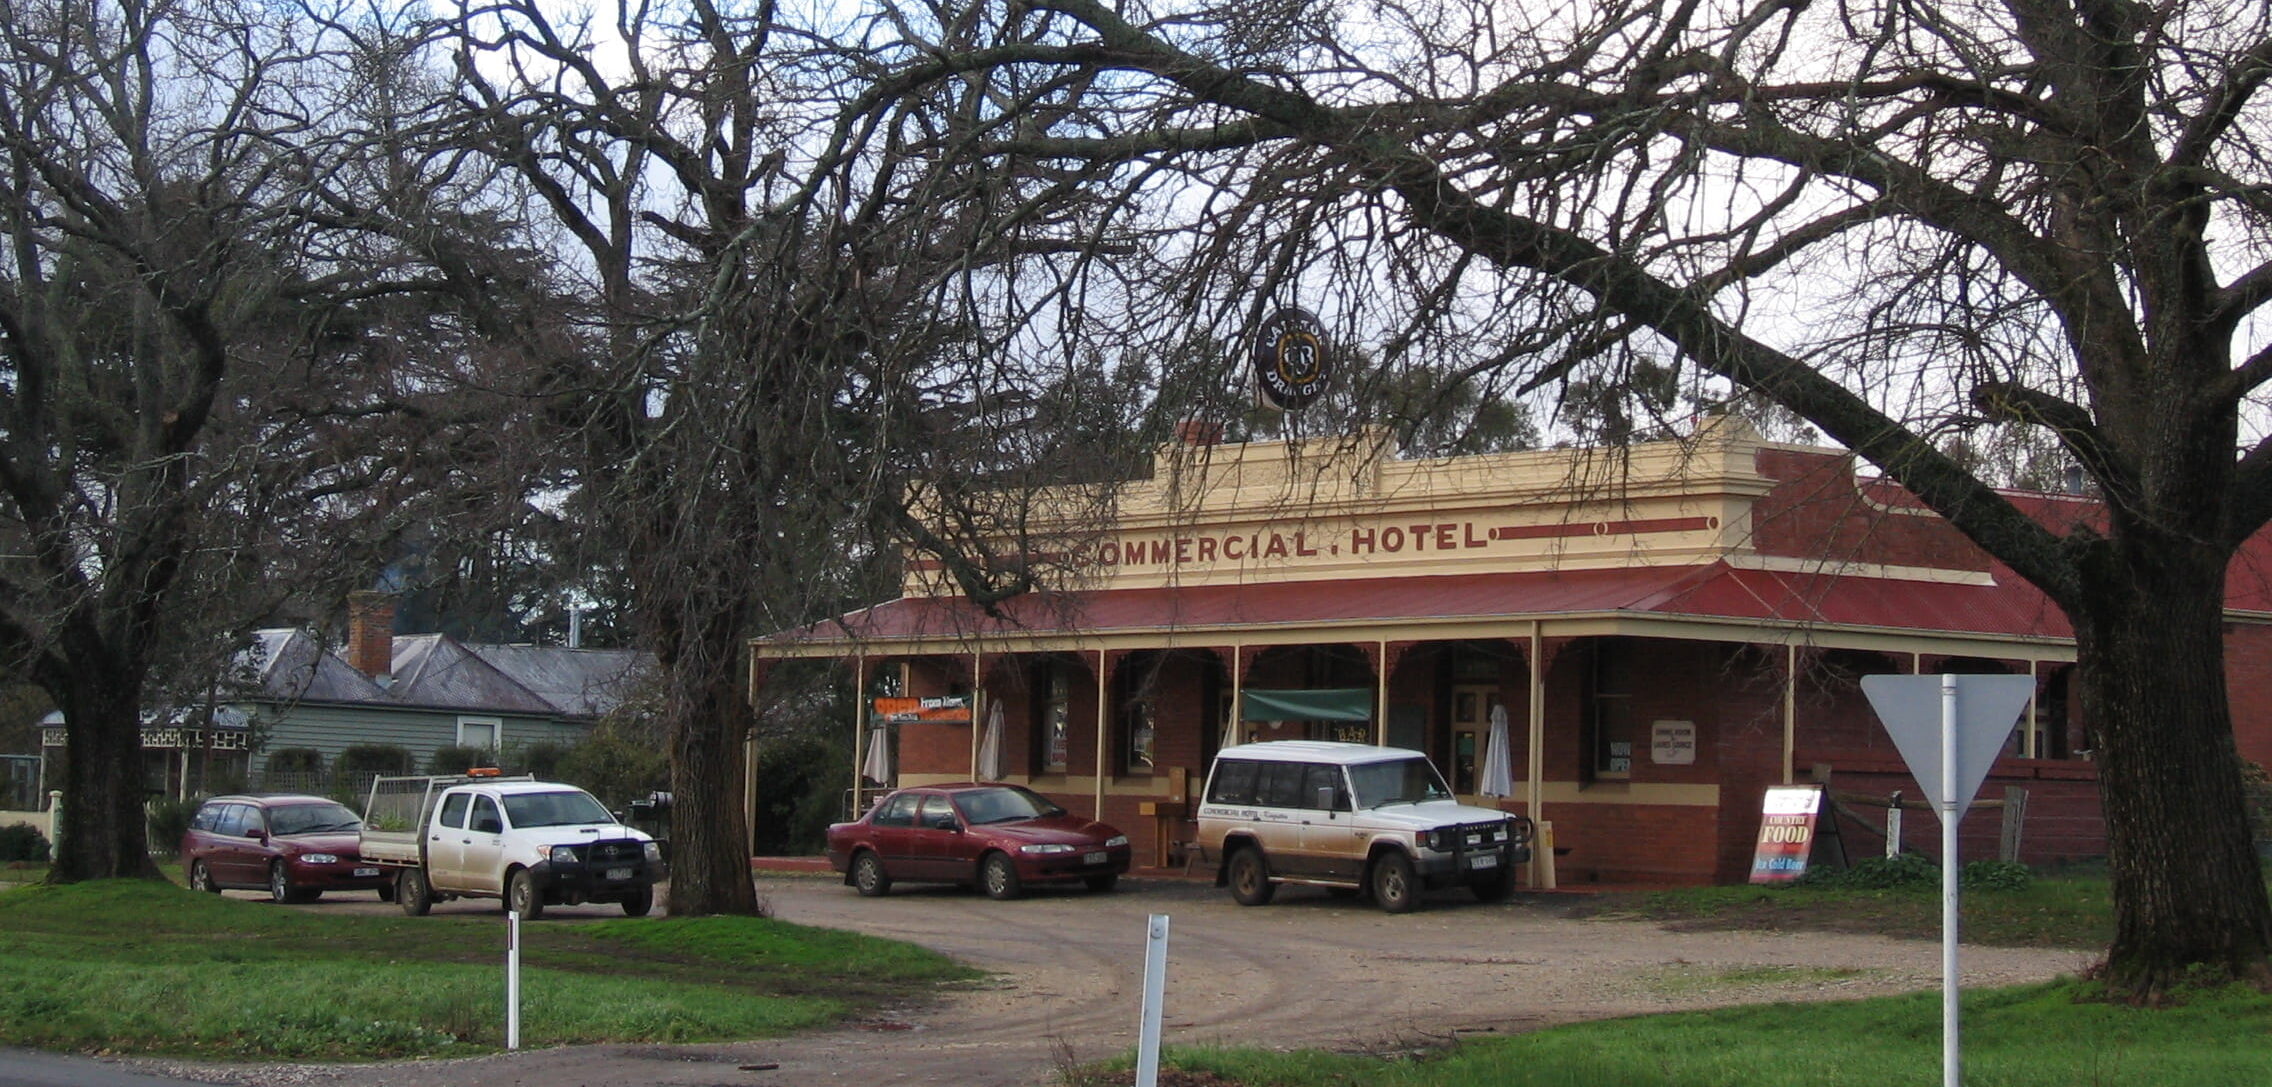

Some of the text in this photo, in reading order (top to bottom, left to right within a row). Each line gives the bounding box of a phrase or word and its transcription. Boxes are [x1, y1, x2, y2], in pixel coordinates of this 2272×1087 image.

[1072, 522, 1488, 567] COMMERCIAL HOTEL
[1769, 815, 1807, 825] COUNTRY
[1761, 826, 1809, 844] FOOD
